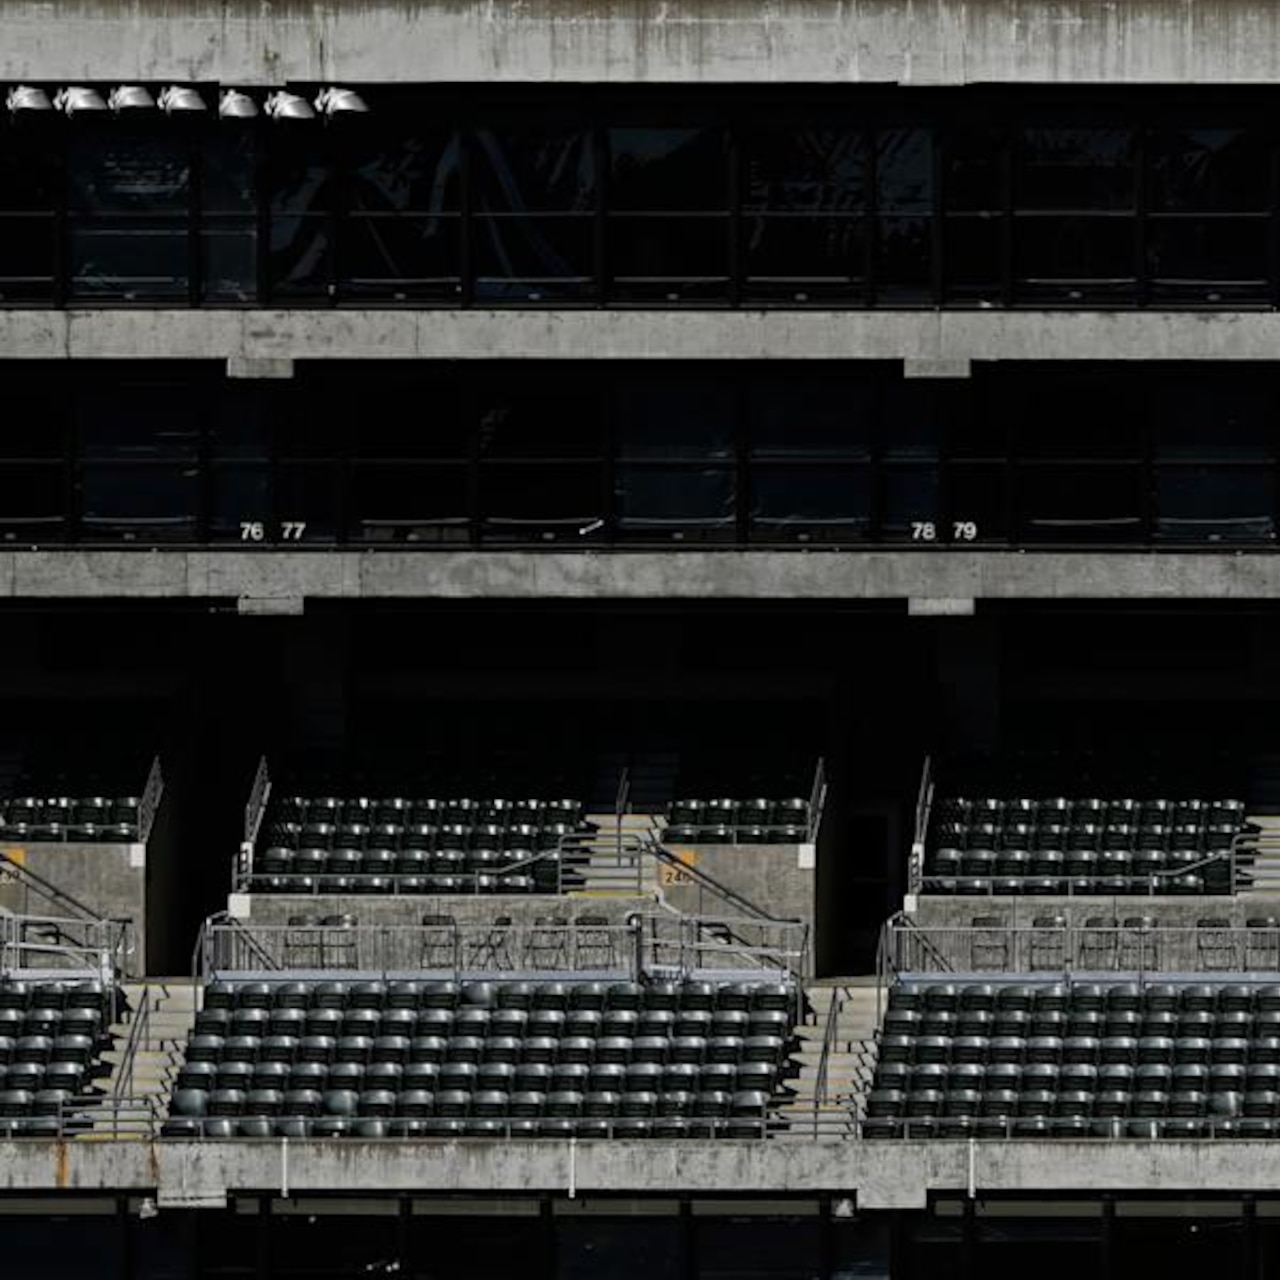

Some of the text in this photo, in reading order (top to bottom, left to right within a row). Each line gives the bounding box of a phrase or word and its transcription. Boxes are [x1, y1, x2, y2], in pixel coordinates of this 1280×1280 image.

[240, 522, 264, 541] 76
[280, 522, 306, 540] 77
[911, 522, 936, 541] 78
[952, 522, 977, 541] 79
